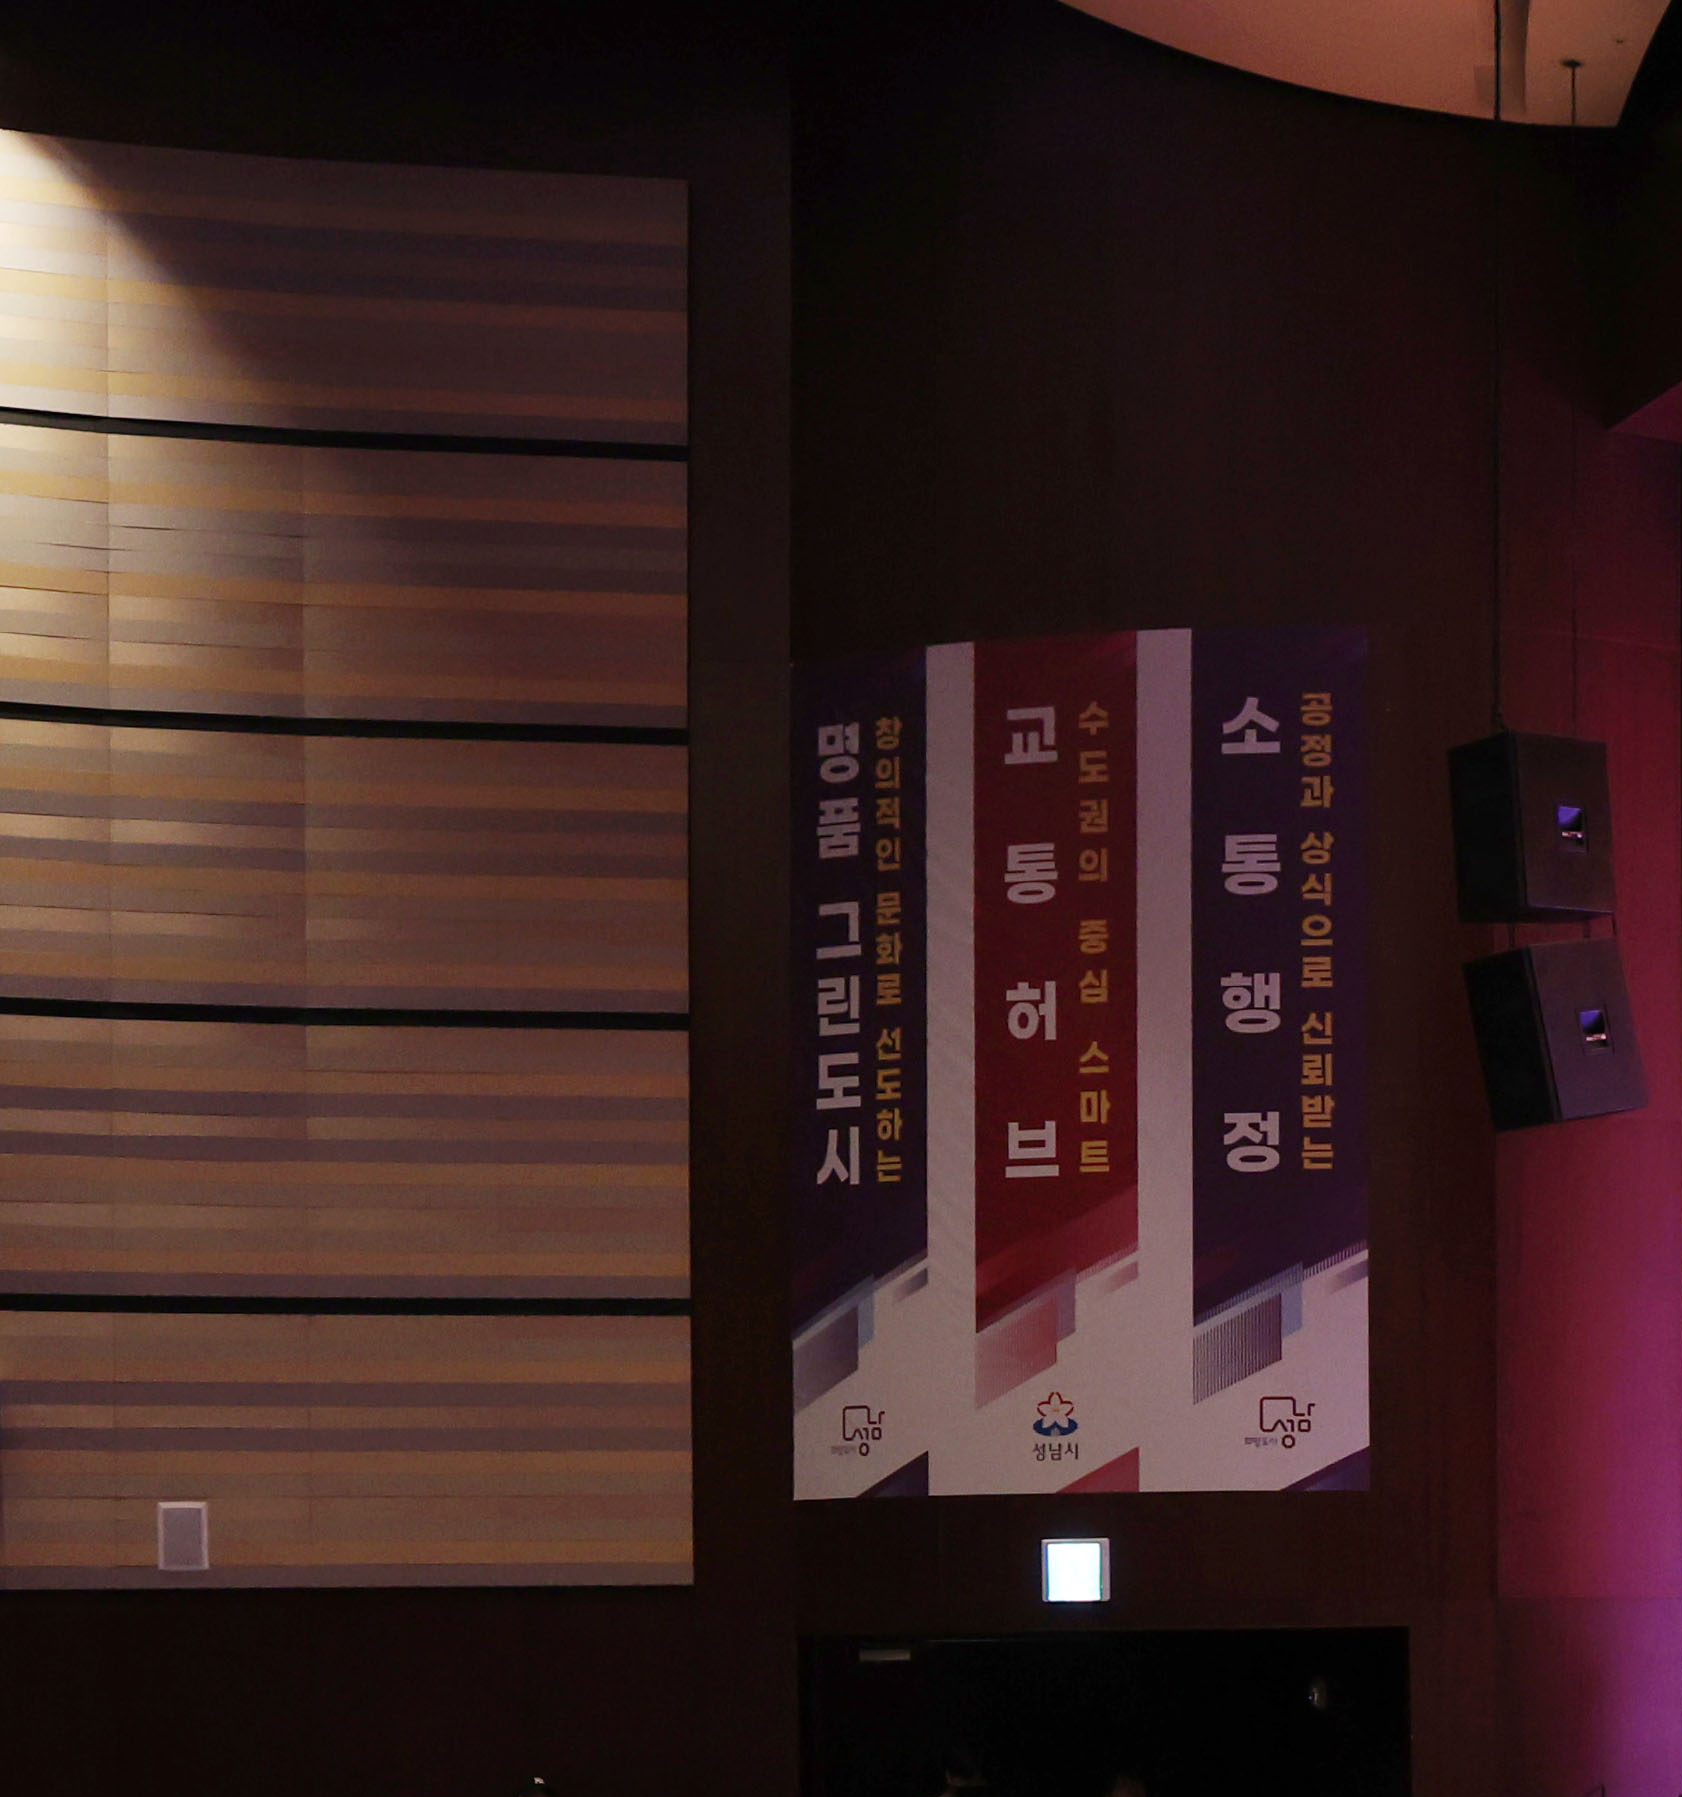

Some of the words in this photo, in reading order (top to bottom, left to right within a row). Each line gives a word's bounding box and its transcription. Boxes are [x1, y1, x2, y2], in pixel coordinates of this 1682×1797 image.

[816, 722, 862, 861] 명품
[875, 716, 903, 872] 창의적인
[1078, 701, 1110, 882] 수도권의
[1300, 692, 1335, 808] 공정과
[875, 891, 903, 1006] 문화로
[1078, 919, 1110, 1004] 중심
[1300, 831, 1335, 988] 상식으로
[816, 900, 862, 1185] 그린도시
[875, 1026, 903, 1184] 선도하는
[1078, 1040, 1110, 1174] 스마트
[1300, 1011, 1335, 1170] 신뢰받는
[1033, 1443, 1078, 1461] 성남시
